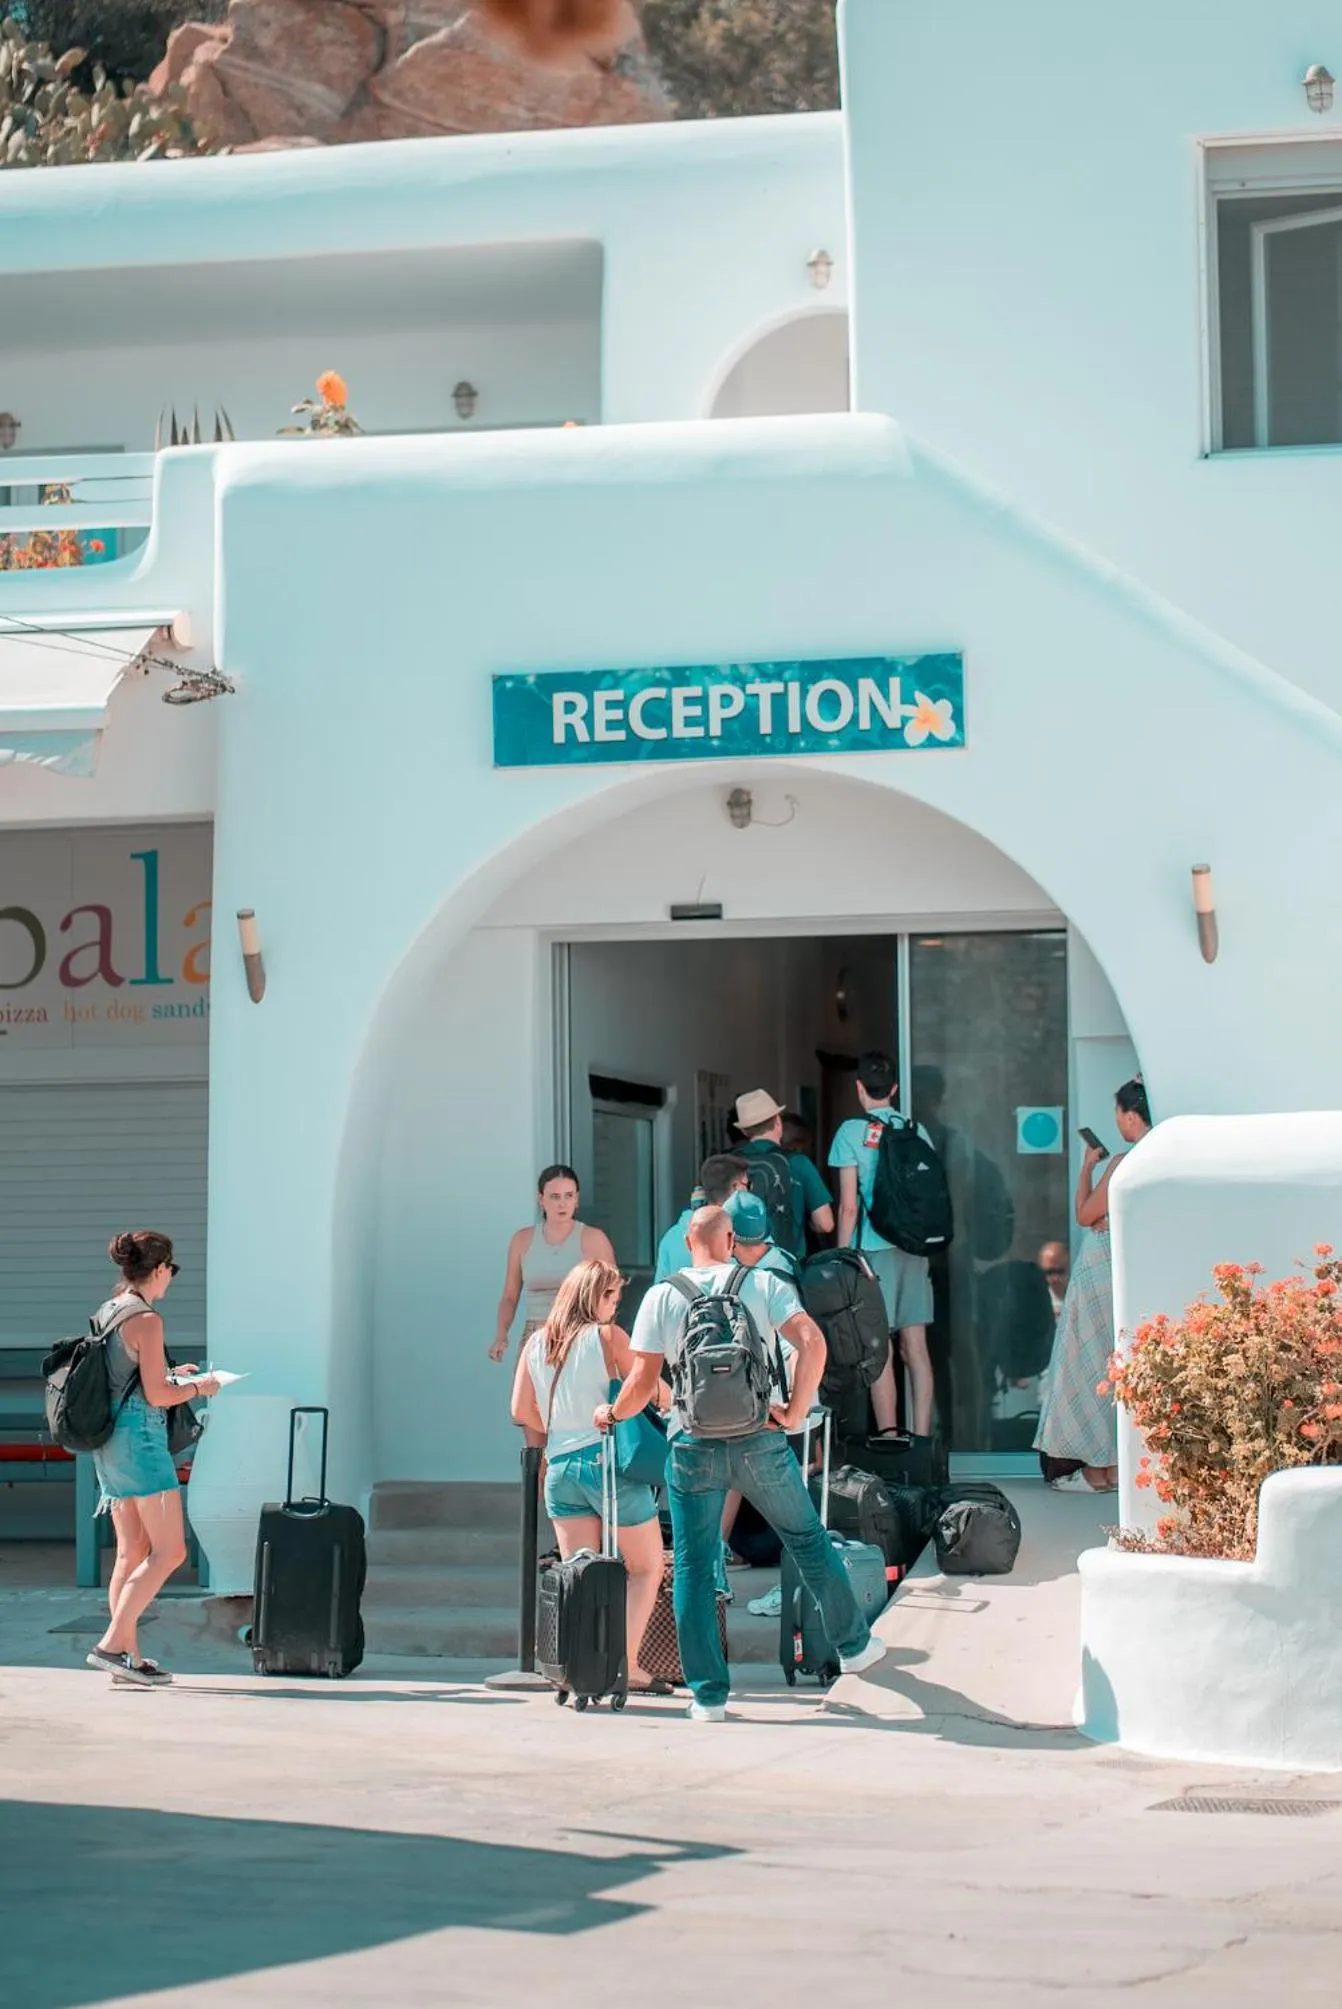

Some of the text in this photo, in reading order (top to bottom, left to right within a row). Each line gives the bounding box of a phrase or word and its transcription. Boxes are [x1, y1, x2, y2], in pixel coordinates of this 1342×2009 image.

[552, 677, 900, 744] RECEPTION
[0, 997, 210, 1024] izza hot dog sand
